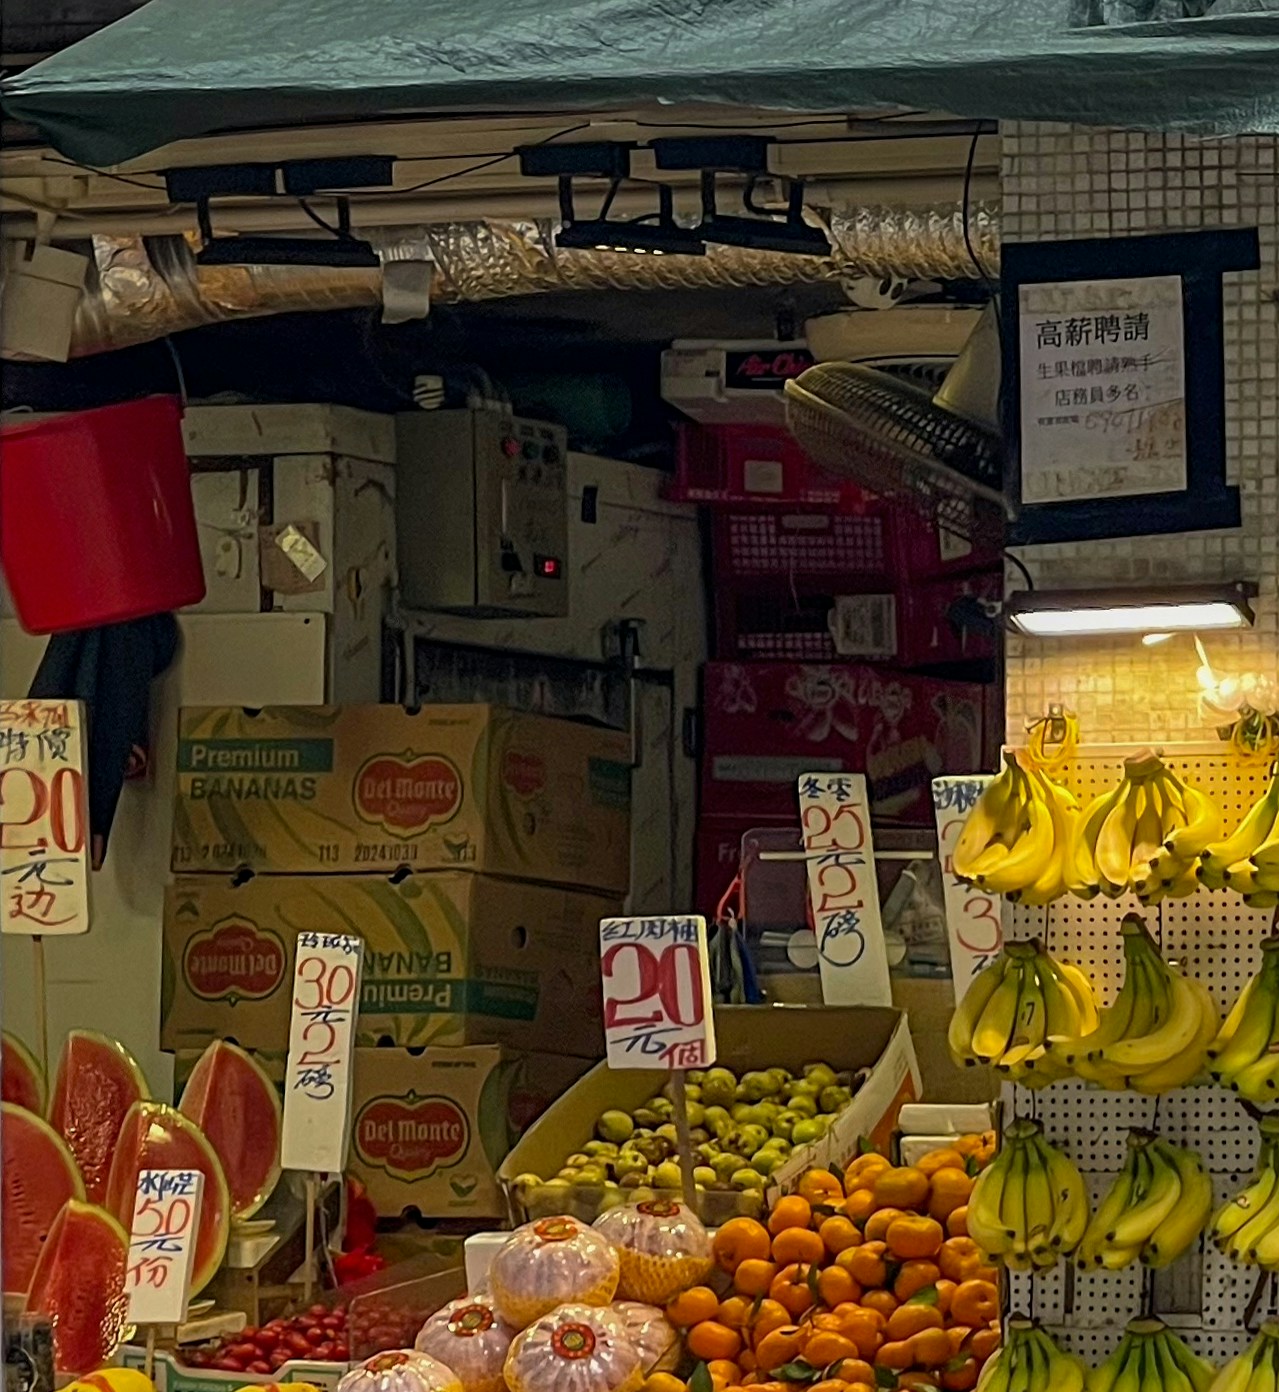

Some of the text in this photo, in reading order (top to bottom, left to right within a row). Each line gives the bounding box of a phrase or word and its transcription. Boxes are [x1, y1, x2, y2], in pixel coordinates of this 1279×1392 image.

[1036, 312, 1149, 349] 高薪聘請
[1055, 384, 1139, 406] 店務員多名
[190, 745, 299, 768] Premium
[190, 777, 316, 801] BANANAS
[364, 778, 455, 800] Del Monte
[0, 767, 86, 853] 20
[803, 803, 864, 850] 25
[2, 850, 80, 885] 元
[803, 848, 866, 866] 元
[10, 882, 78, 926] 边
[816, 864, 864, 912] 2
[957, 896, 1002, 952] 3
[364, 951, 452, 973] BANAN
[295, 957, 354, 1010] 30
[363, 984, 451, 1008] Premiu
[601, 942, 704, 1029] 20
[301, 1004, 350, 1023] 元
[296, 1021, 341, 1065] 2
[610, 1024, 684, 1054] 元
[364, 1119, 461, 1143] Del Monte
[131, 1197, 191, 1237] 50
[130, 1233, 183, 1252] 元
[127, 1256, 174, 1288] 份
